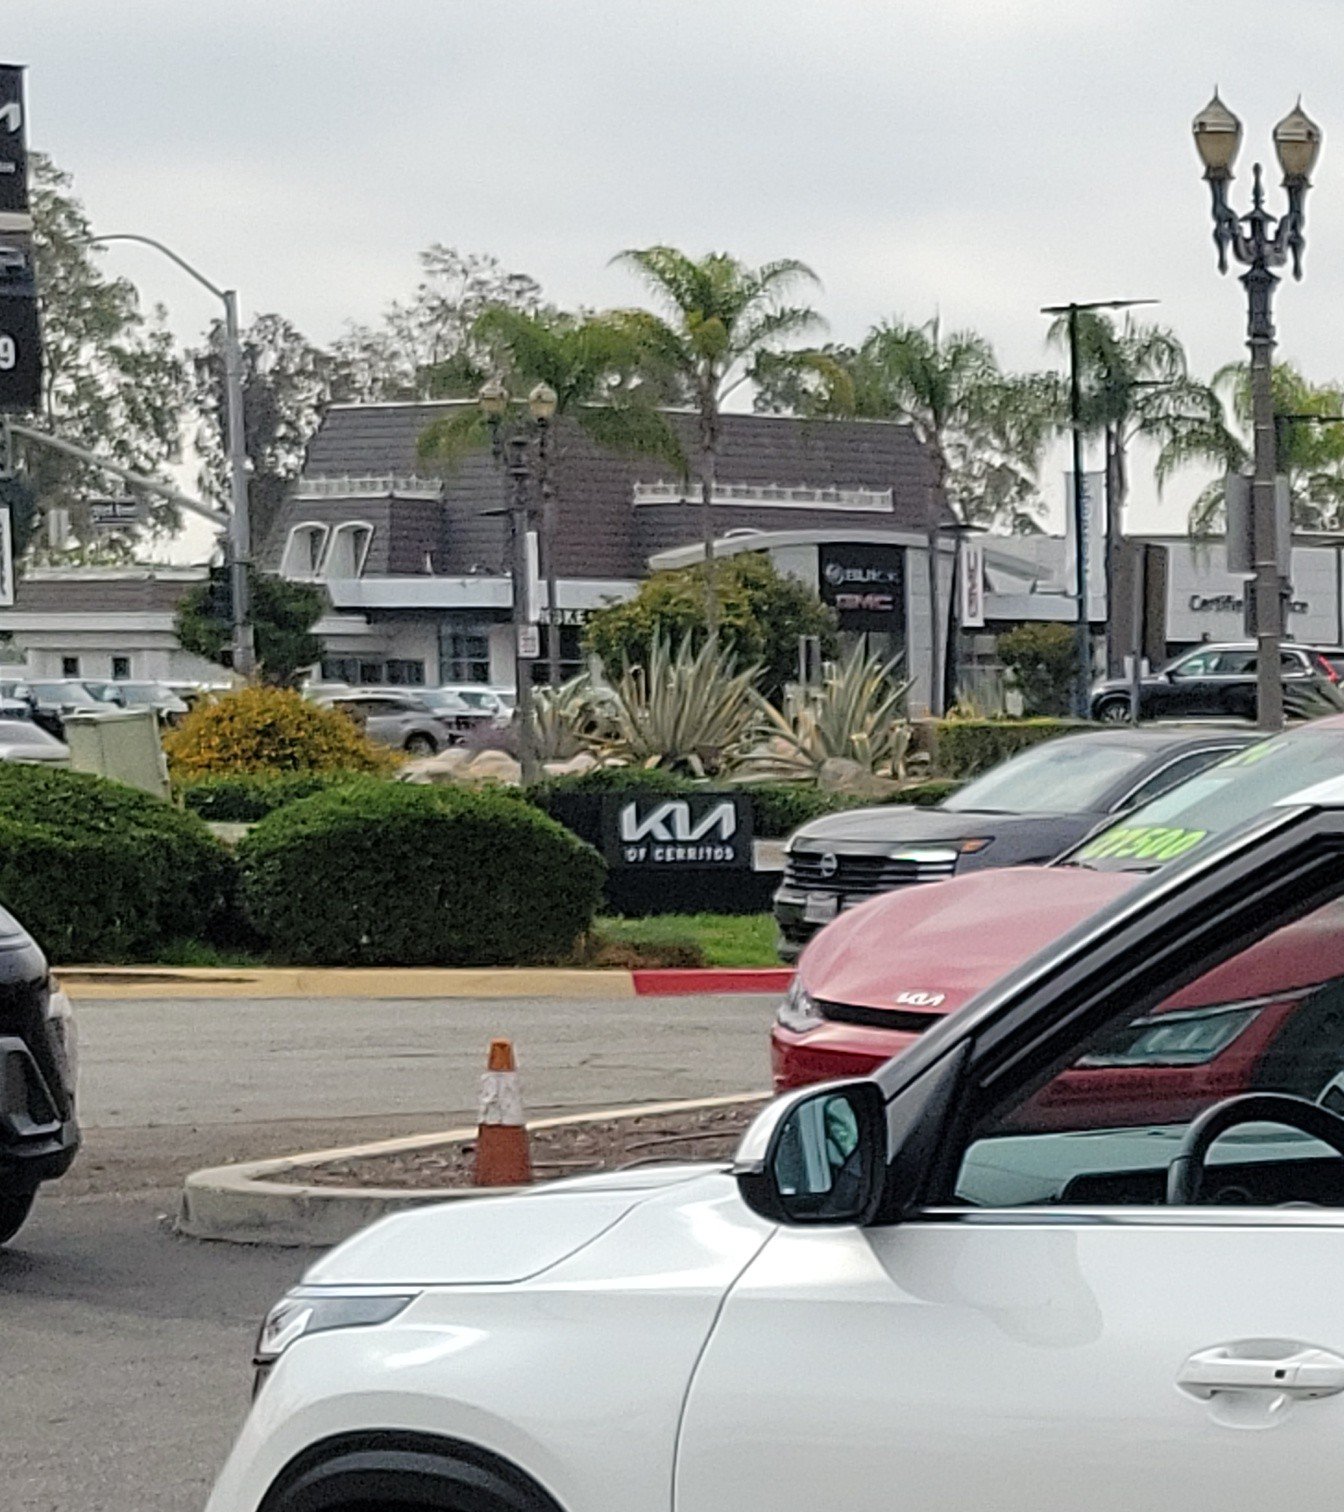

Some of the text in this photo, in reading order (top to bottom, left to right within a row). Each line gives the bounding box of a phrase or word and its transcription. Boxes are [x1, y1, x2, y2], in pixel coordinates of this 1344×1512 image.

[622, 802, 736, 842] KIA
[626, 846, 735, 862] OF CERRITOS
[895, 991, 946, 1007] KIA
